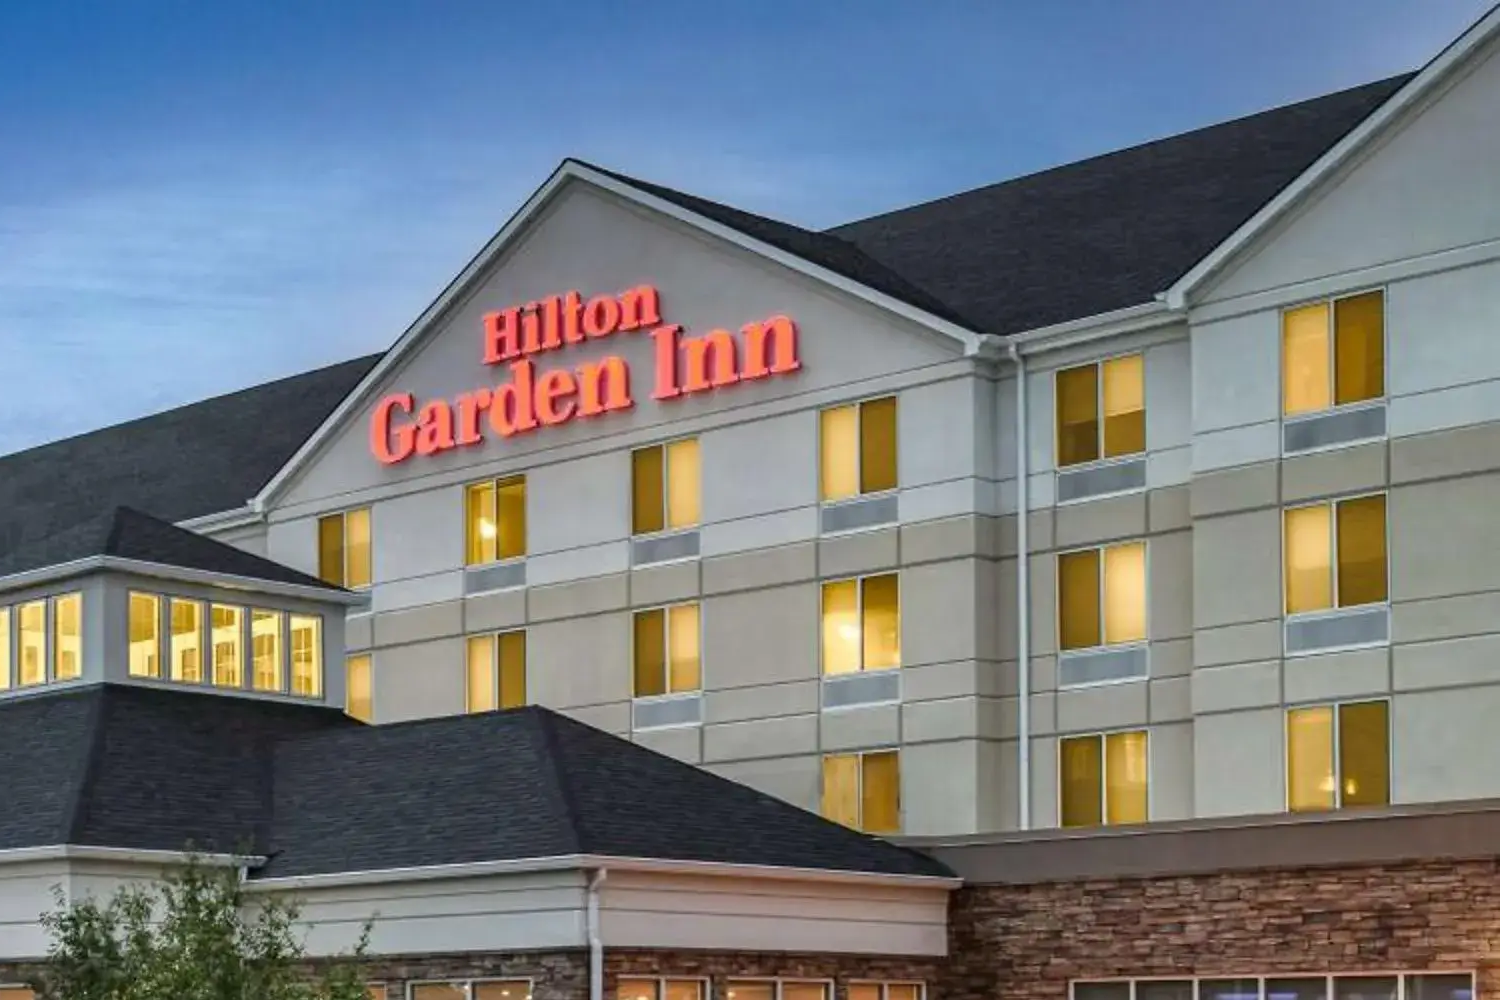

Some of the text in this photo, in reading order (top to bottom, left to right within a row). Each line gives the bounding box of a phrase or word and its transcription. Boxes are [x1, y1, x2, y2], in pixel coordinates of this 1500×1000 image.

[482, 284, 661, 364] Hilton
[370, 313, 800, 465] Garden Inn
